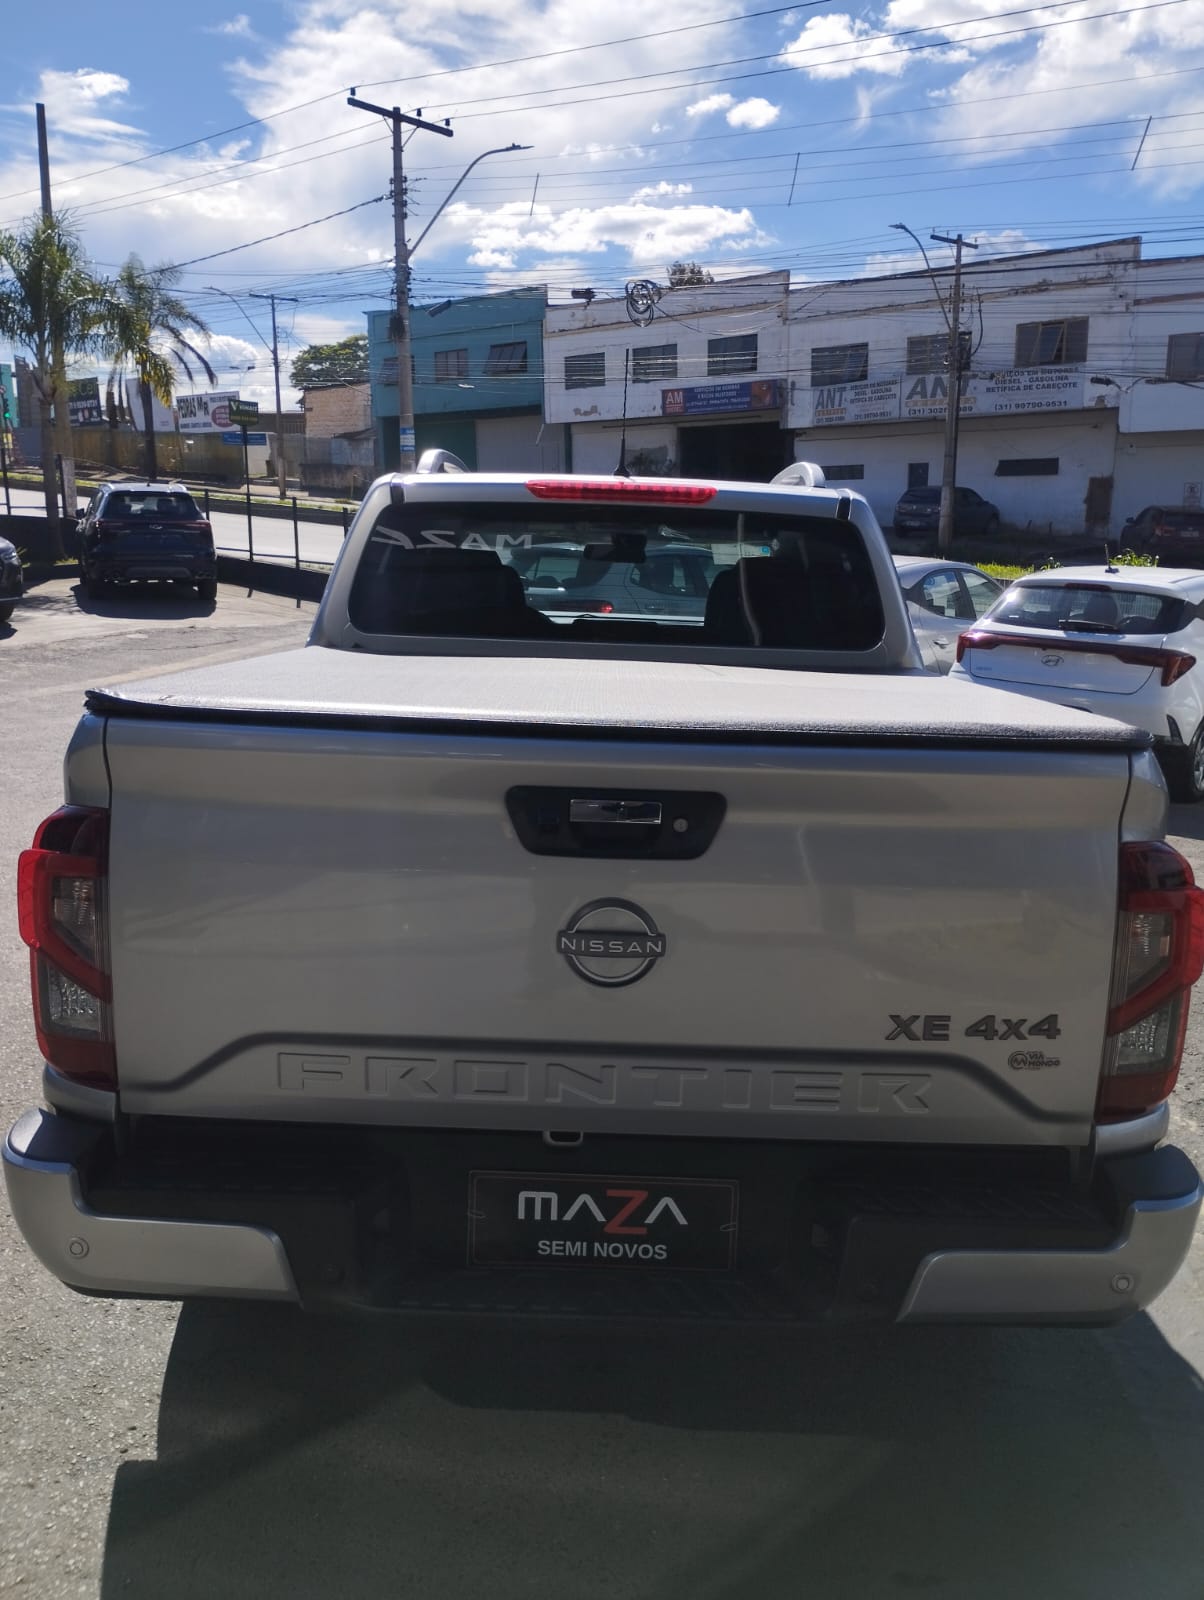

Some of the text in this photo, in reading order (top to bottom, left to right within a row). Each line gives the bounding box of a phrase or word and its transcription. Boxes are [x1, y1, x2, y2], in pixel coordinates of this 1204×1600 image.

[994, 377, 1023, 385] DIESEL
[1028, 375, 1070, 384] GASOLINA
[1035, 382, 1079, 391] CABEÇOTE
[666, 391, 684, 405] AM
[815, 386, 847, 409] ANT
[993, 403, 1012, 412] (31)
[561, 936, 662, 953] NISSAN
[884, 1013, 1062, 1042] XE 4x4
[277, 1052, 933, 1114] FRONTIER
[537, 1239, 668, 1261] SEMI NOVOS
